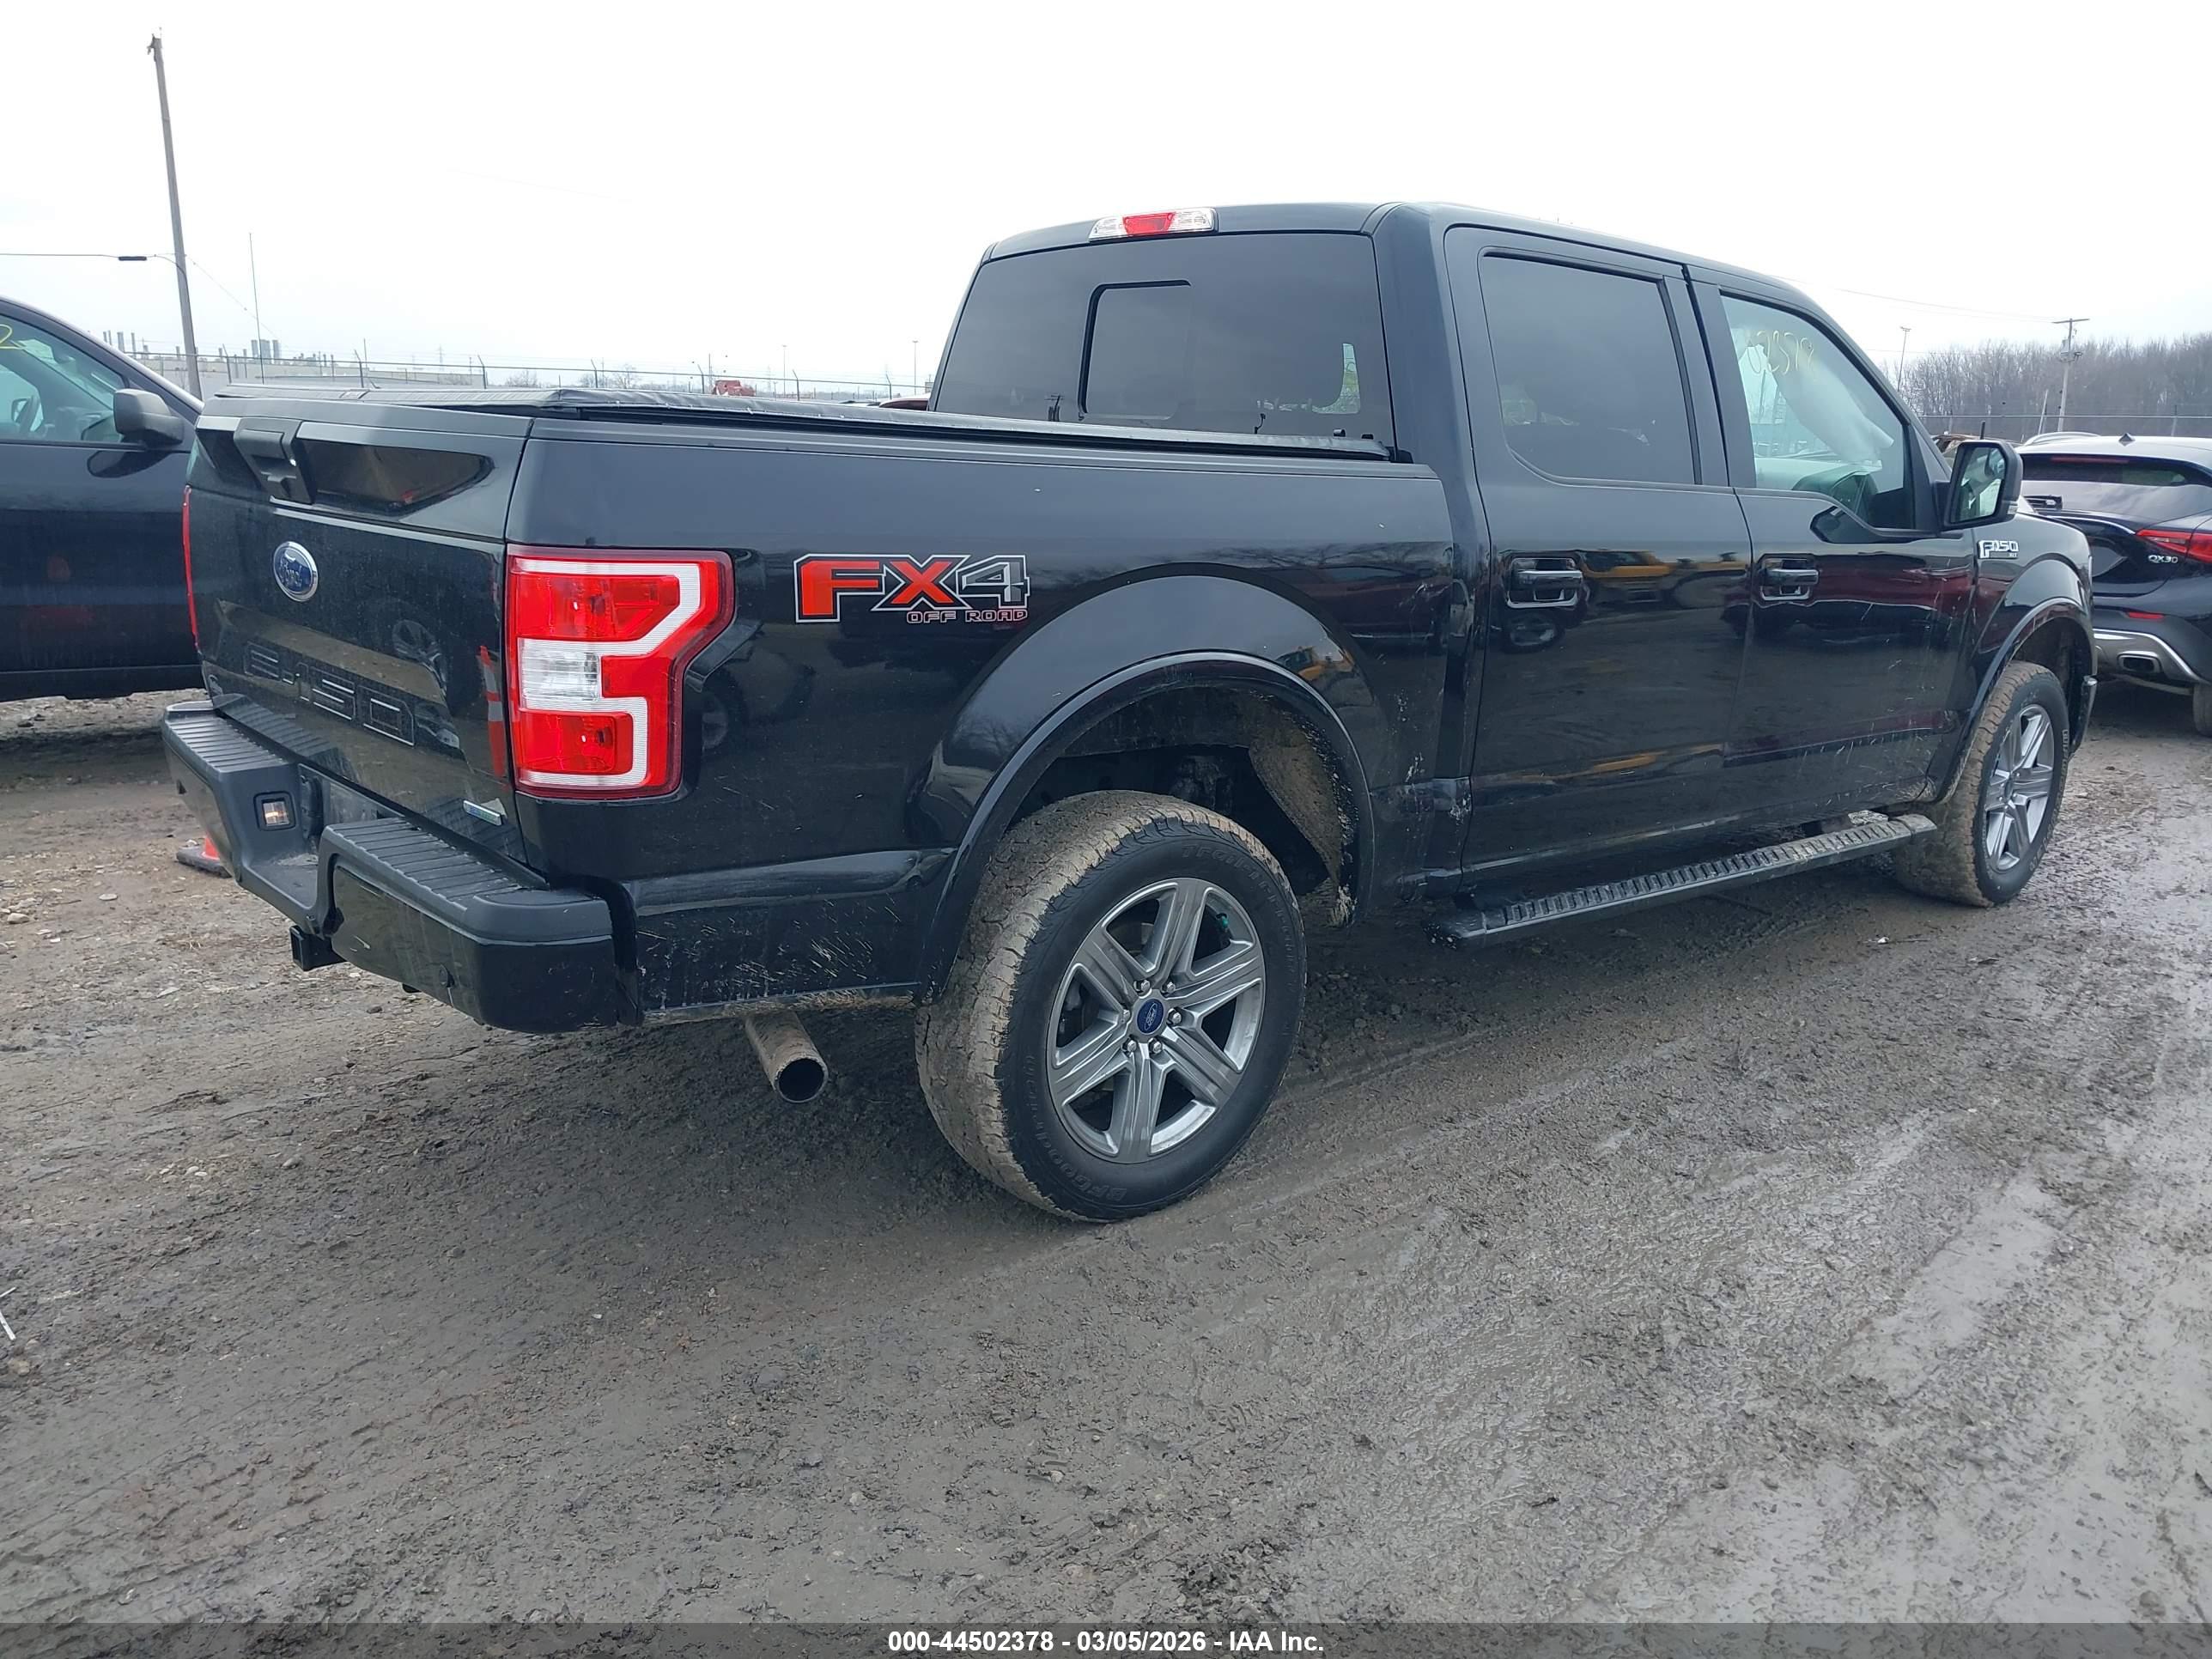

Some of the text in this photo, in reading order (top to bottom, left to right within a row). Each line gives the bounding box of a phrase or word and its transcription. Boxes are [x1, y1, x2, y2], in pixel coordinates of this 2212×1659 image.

[2148, 555, 2179, 563] QX30
[793, 553, 1030, 623] FX4
[906, 609, 1028, 623] OFF ROAD
